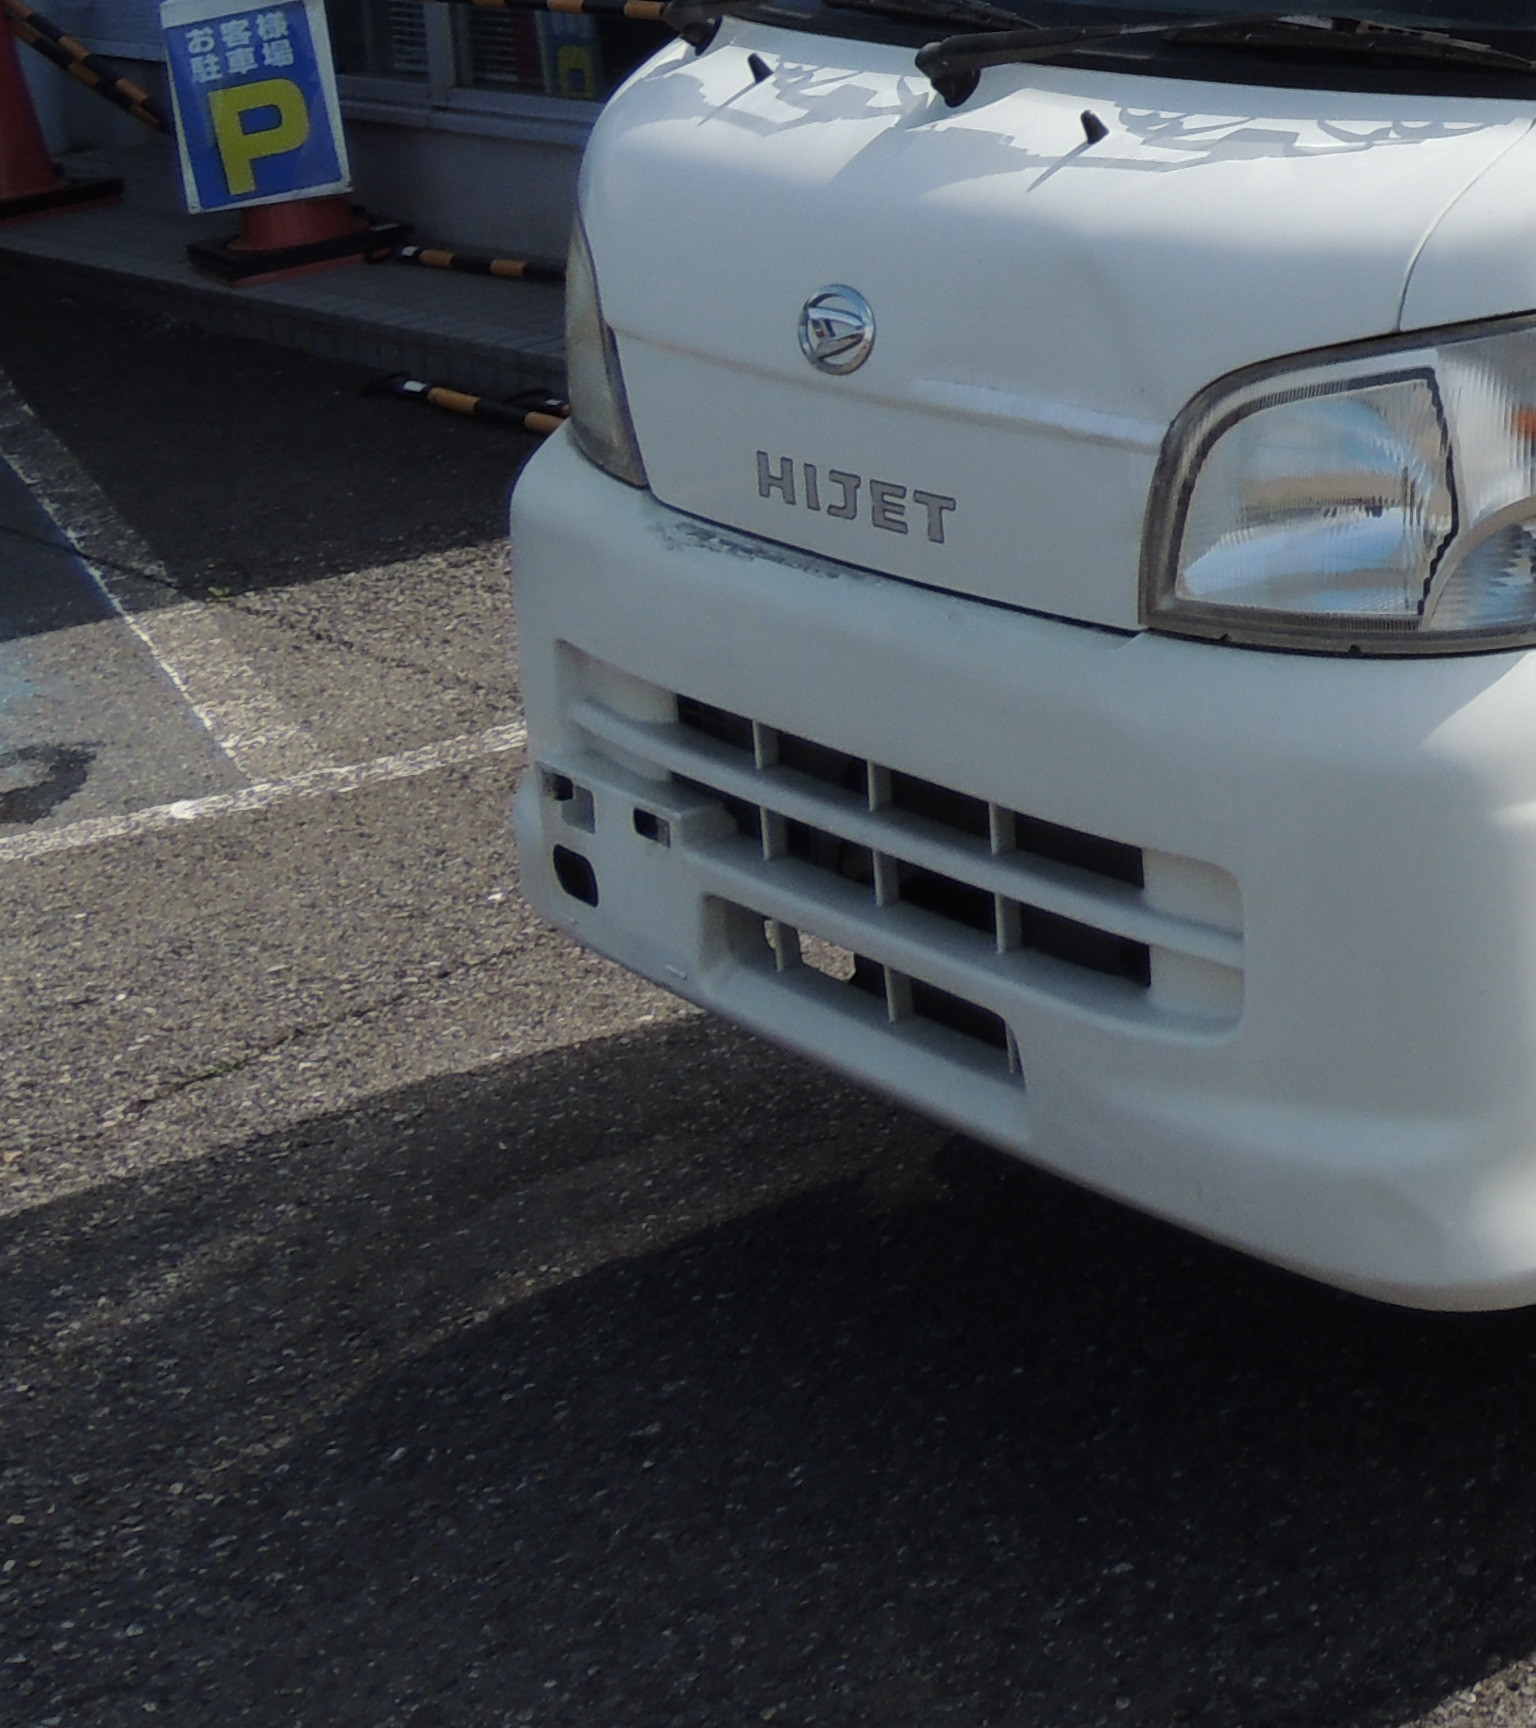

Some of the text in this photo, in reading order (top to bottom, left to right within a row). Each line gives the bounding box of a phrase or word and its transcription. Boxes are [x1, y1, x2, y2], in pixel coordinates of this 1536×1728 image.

[185, 10, 289, 55] お客様
[190, 38, 294, 84] 駐車場
[207, 78, 311, 196] P
[756, 450, 956, 544] HIJET
